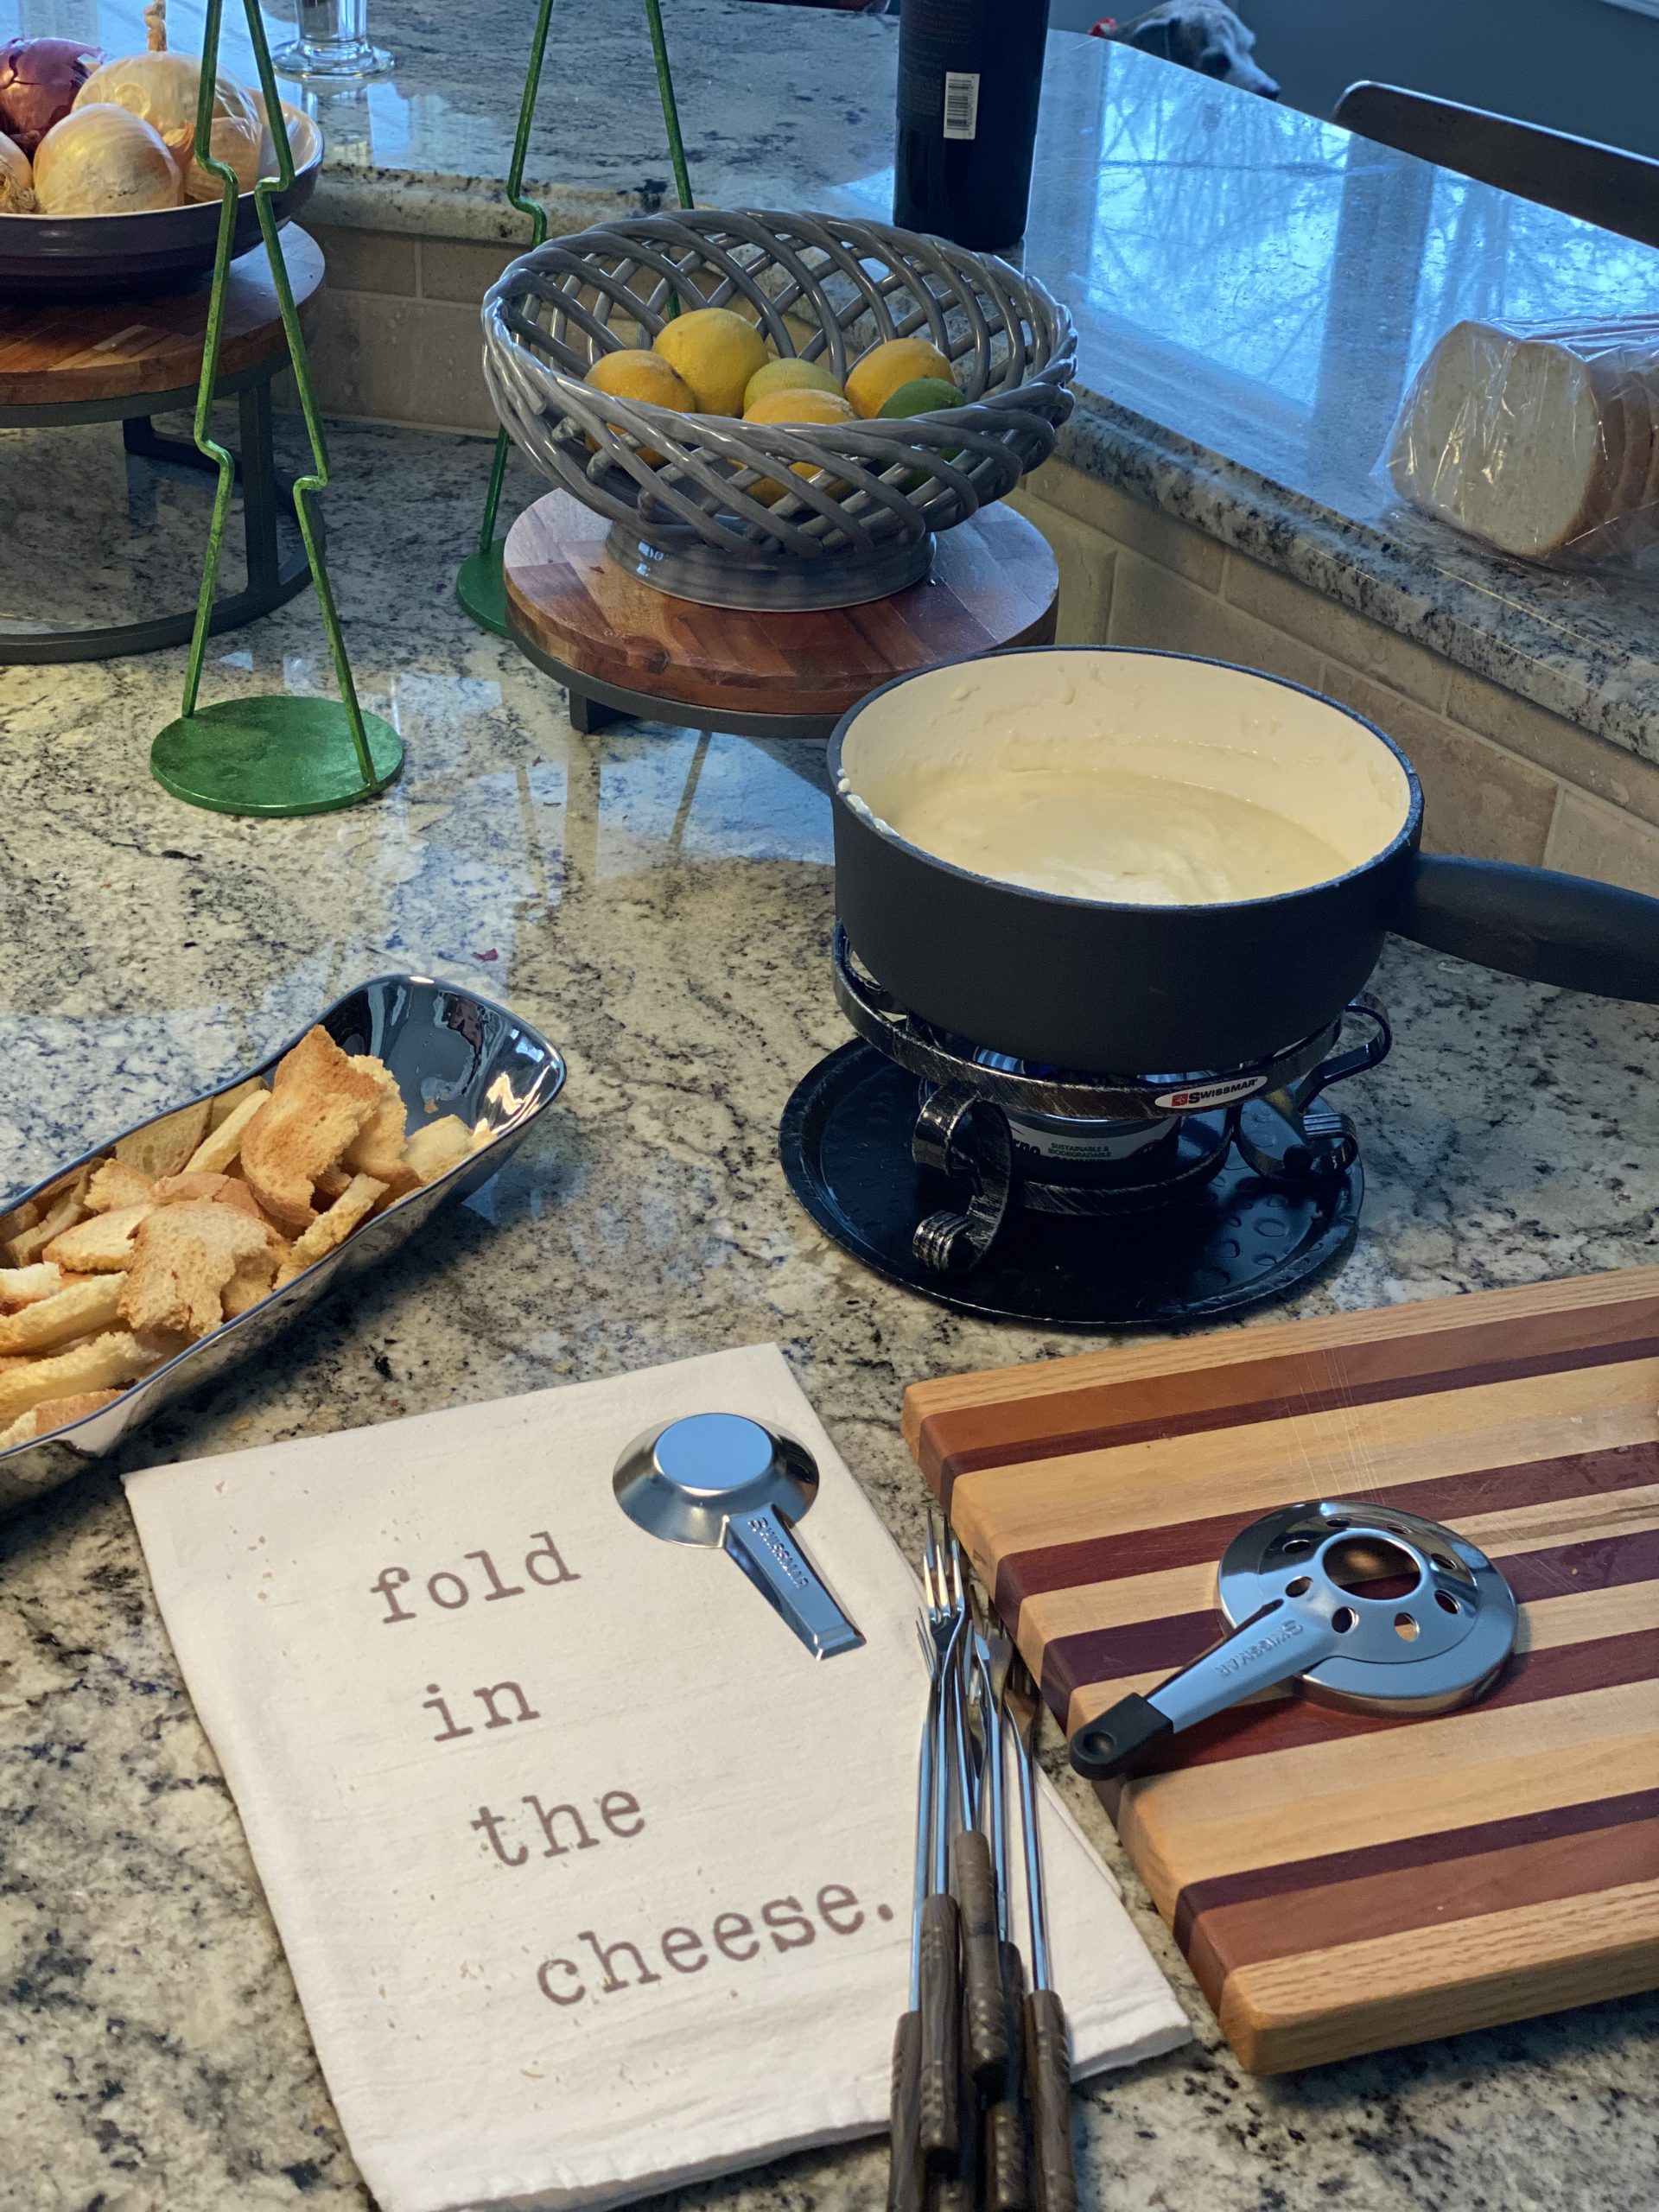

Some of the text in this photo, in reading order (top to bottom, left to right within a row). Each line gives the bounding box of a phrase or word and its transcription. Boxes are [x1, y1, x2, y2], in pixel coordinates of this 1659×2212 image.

[1013, 1138, 1041, 1155] rno
[1048, 1147, 1112, 1158] BIODEGRADABLE
[1051, 1142, 1102, 1153] SUSTAINABLE
[370, 1531, 581, 1624] fold
[747, 1516, 809, 1590] SWISSMAR
[422, 1679, 541, 1742] in
[471, 1790, 645, 1867] the
[536, 1884, 893, 2006] cheese.
